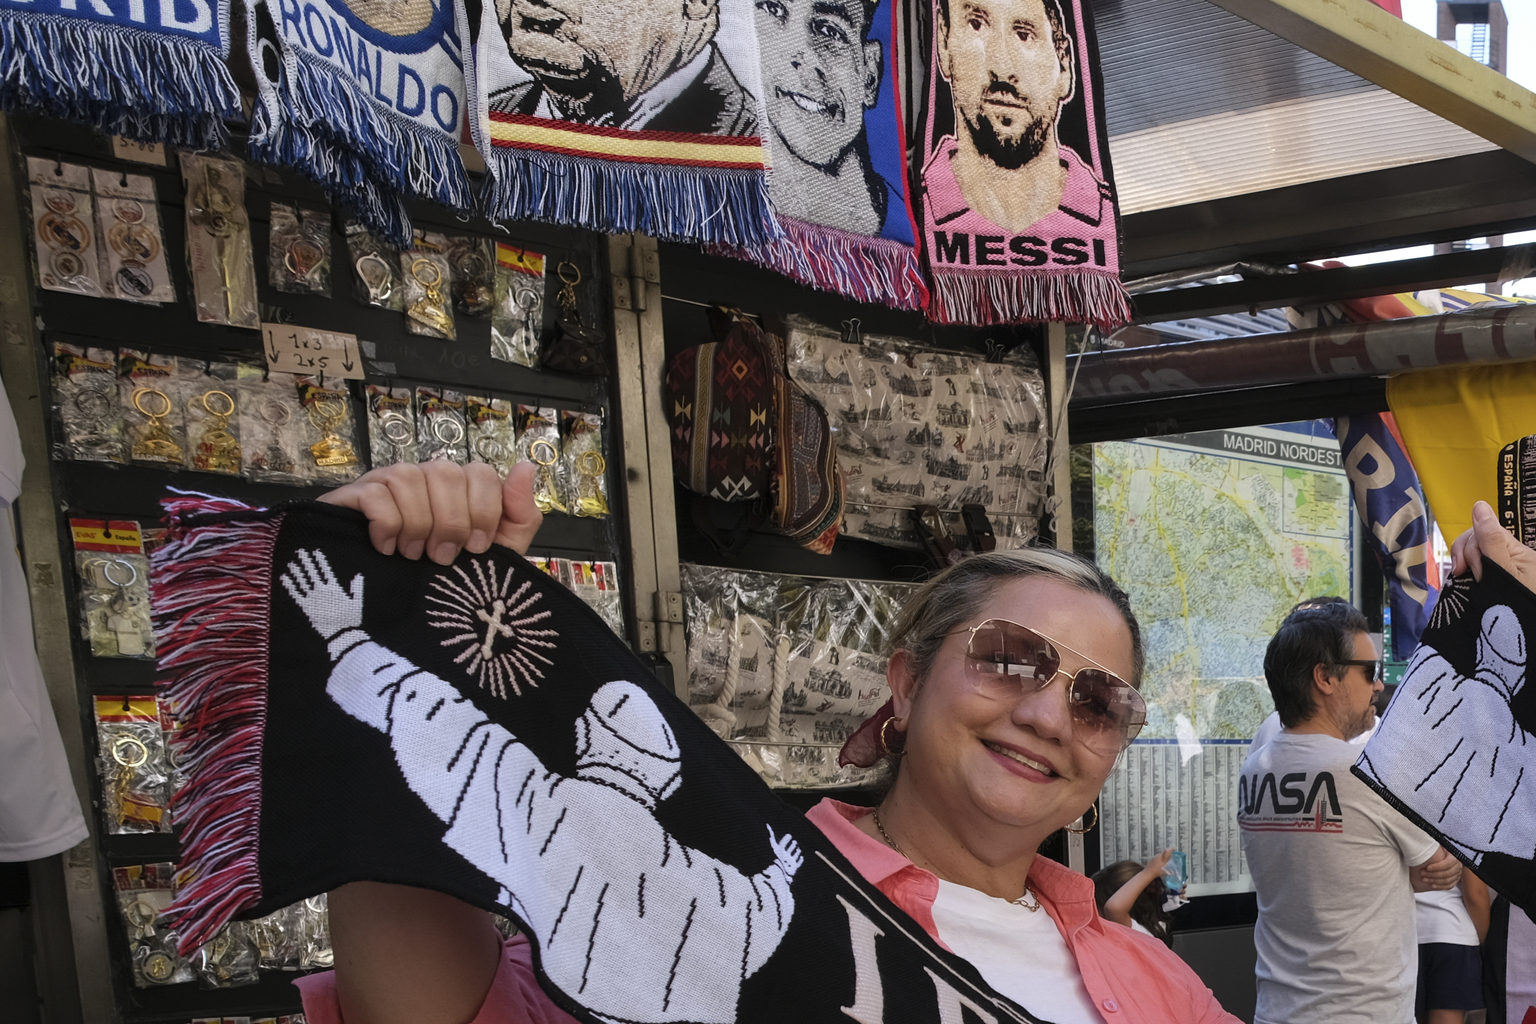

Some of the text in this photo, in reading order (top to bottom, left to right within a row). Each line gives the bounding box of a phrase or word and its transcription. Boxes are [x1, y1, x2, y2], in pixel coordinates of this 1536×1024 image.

[279, 0, 459, 133] RONALDO
[934, 230, 1105, 267] MESSI
[1224, 433, 1344, 466] MADRID NORDEST
[1503, 453, 1518, 496] ESPAÑA
[1239, 771, 1342, 815] NASA
